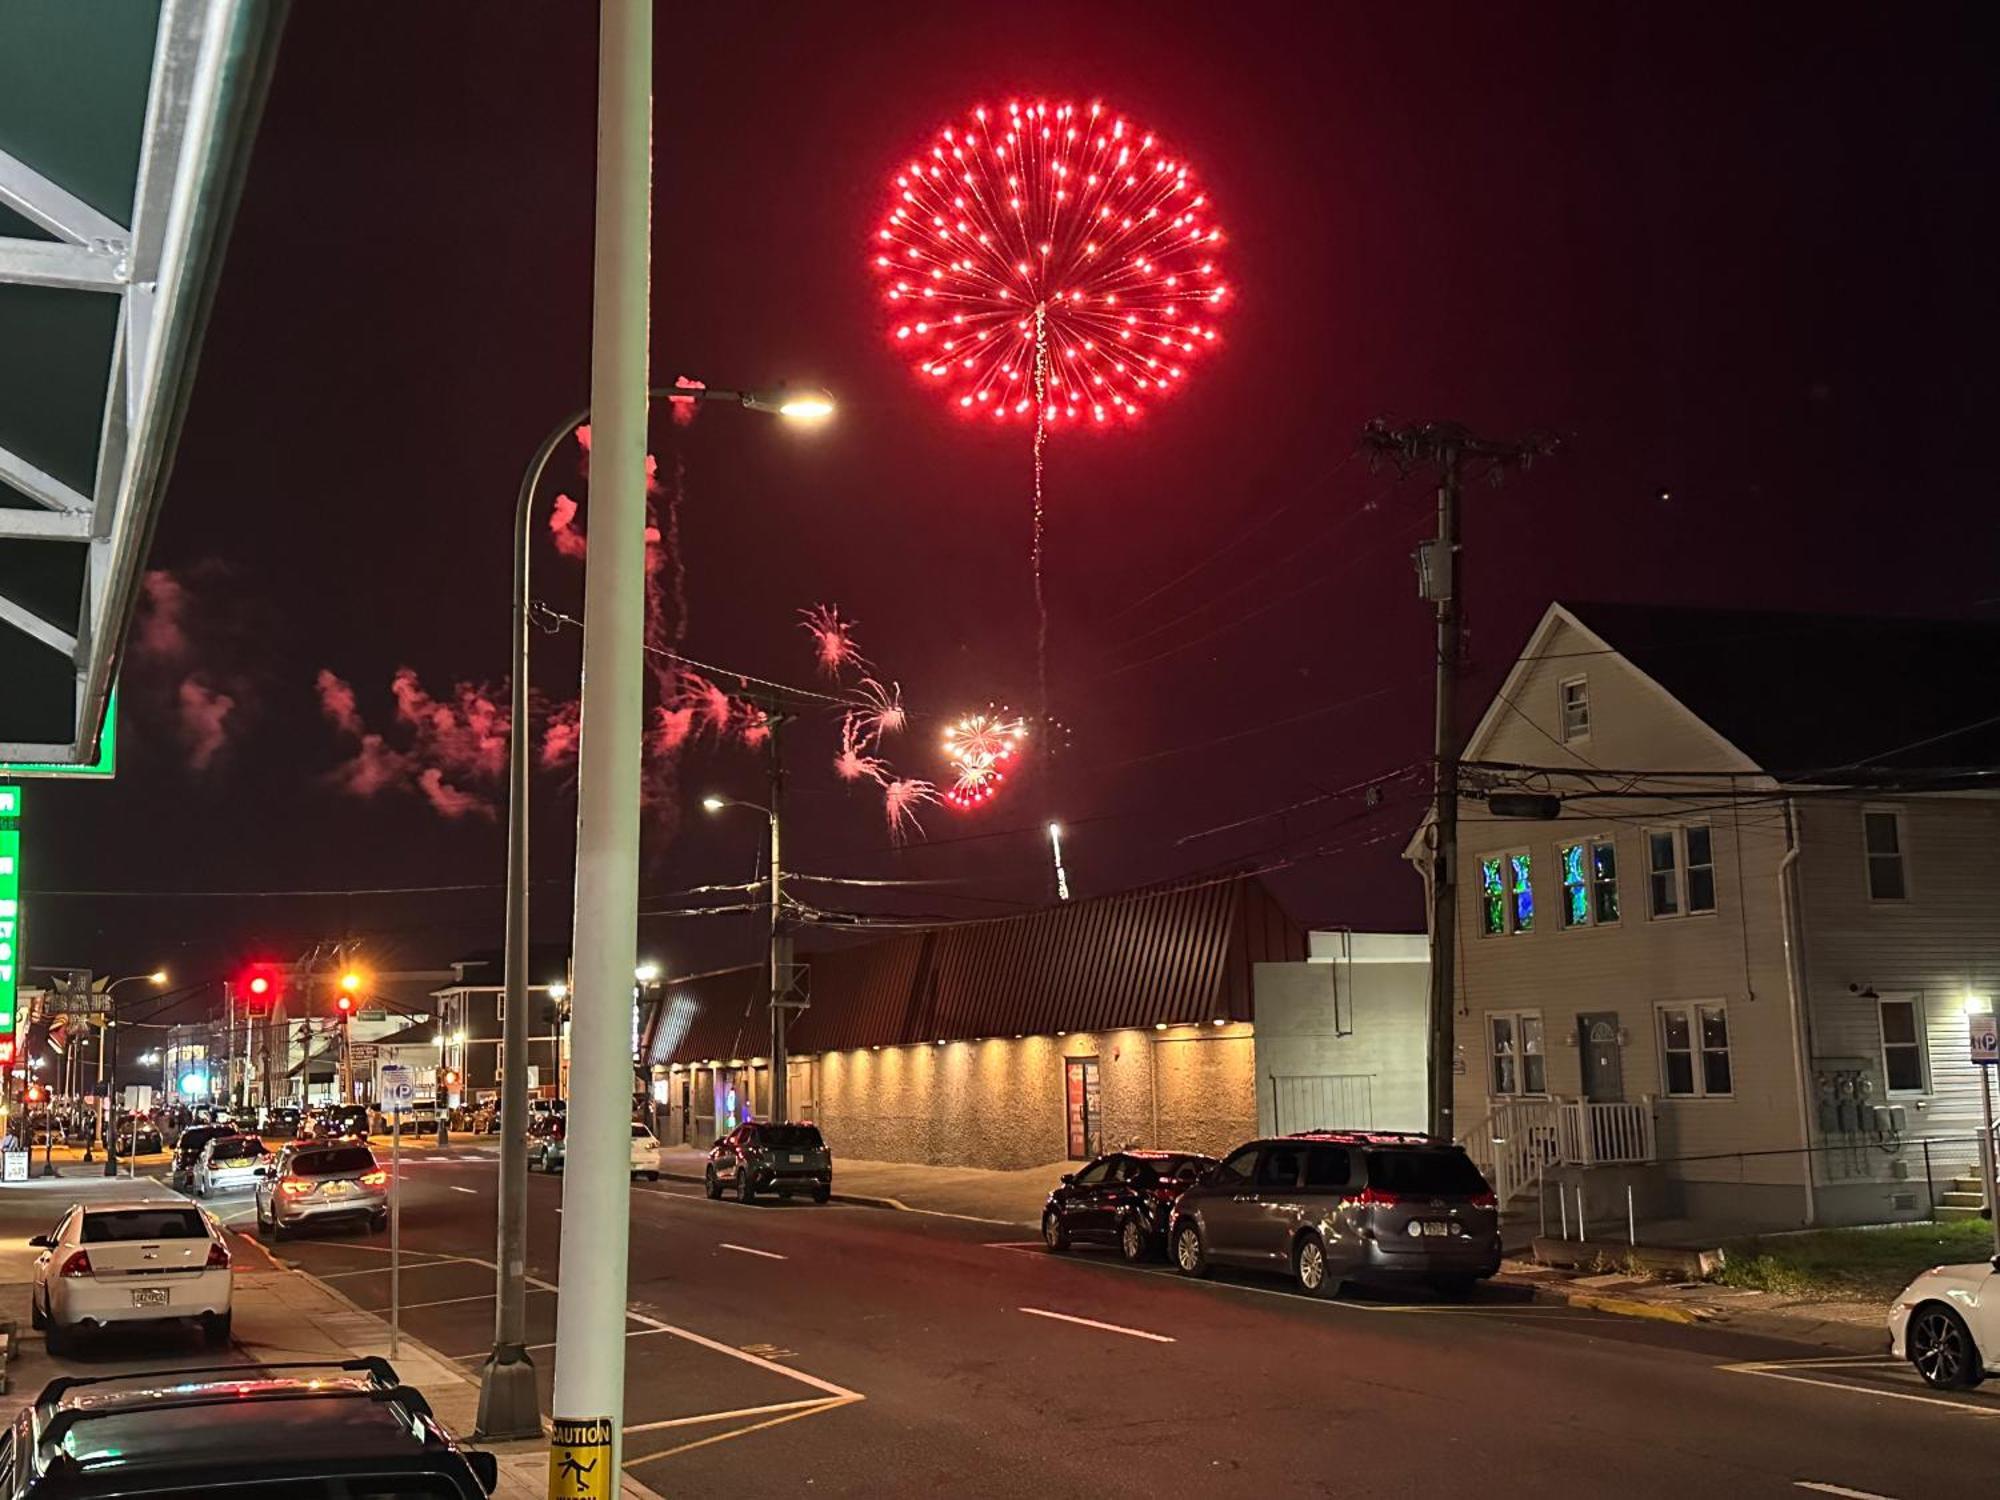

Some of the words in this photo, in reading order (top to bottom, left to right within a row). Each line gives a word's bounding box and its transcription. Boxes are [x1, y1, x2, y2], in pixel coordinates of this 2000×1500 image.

[1986, 1035, 1995, 1051] P
[400, 1085, 411, 1098] P
[552, 1426, 610, 1443] CAUTION
